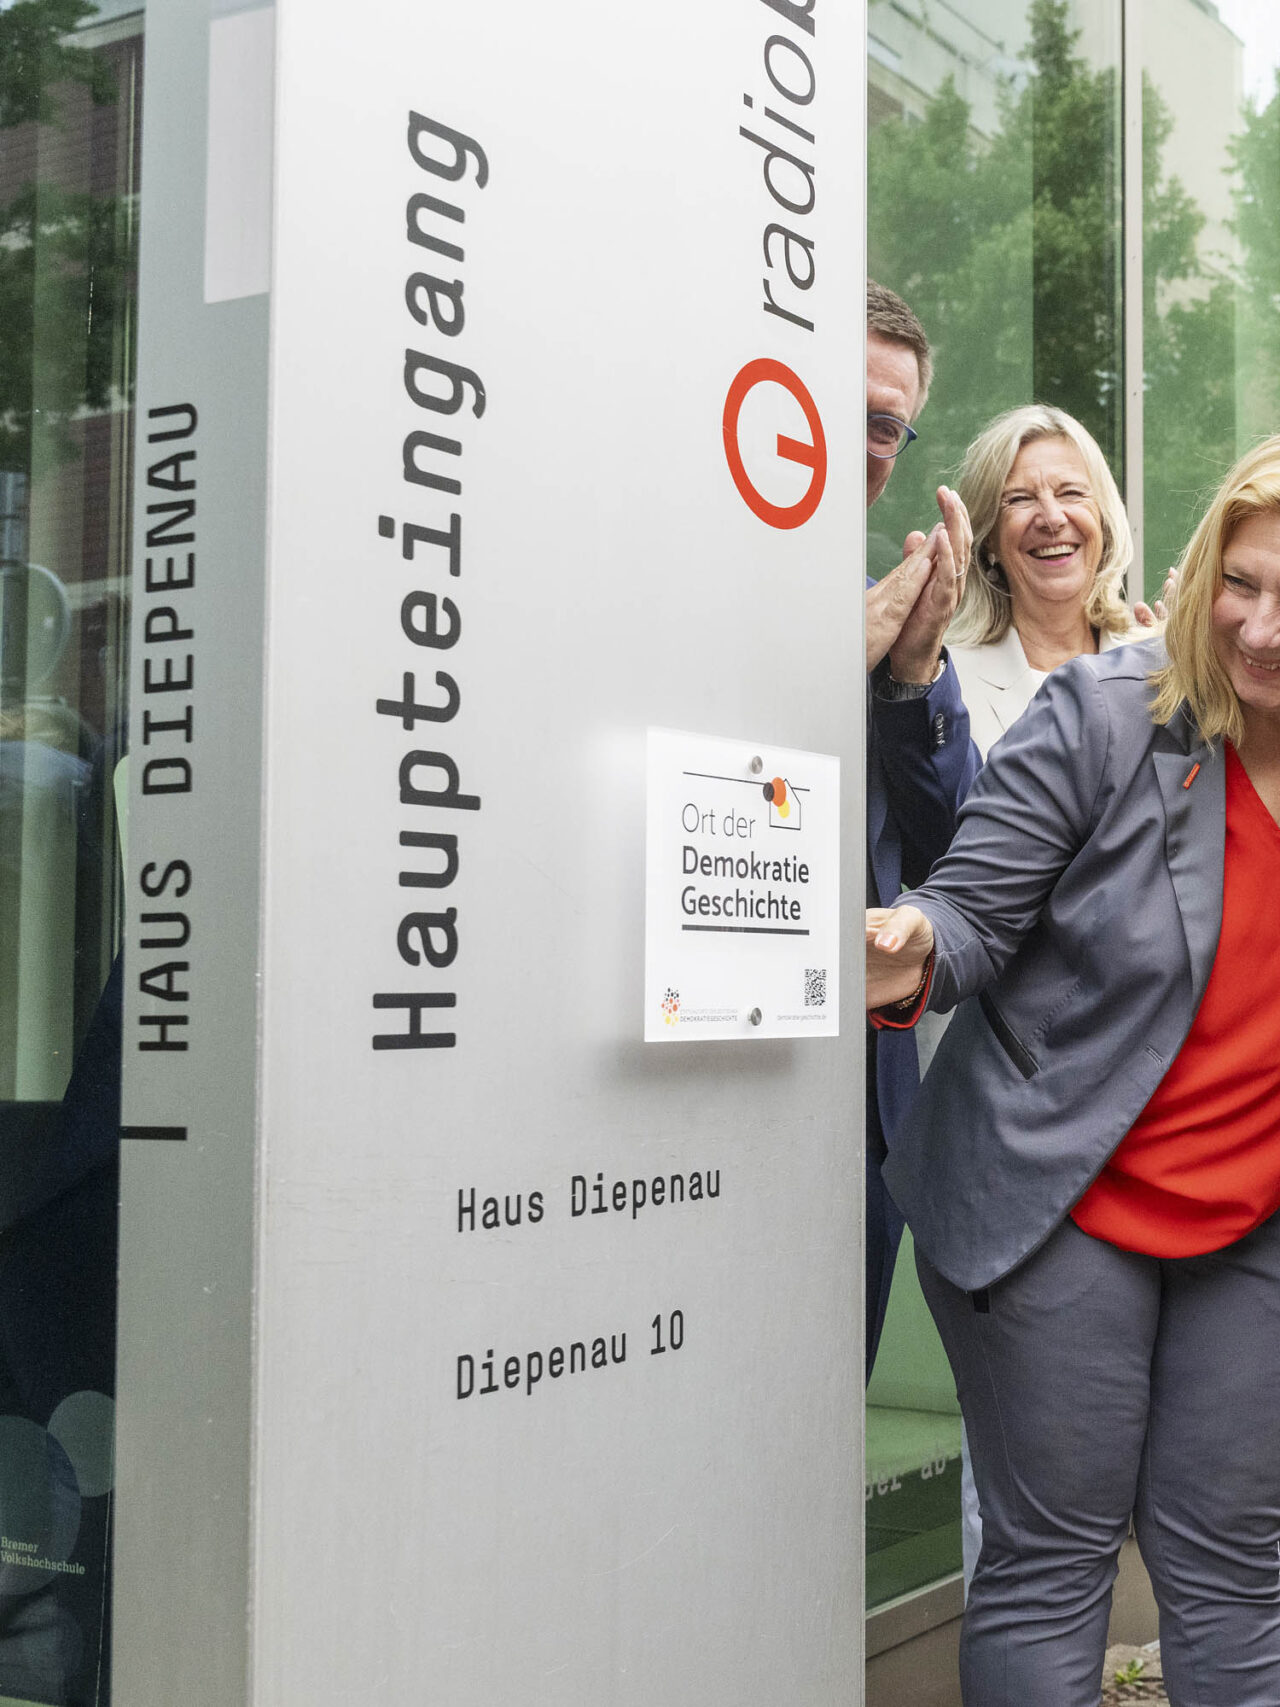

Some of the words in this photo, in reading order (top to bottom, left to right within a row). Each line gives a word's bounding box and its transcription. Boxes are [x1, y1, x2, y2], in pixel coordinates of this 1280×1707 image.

[143, 402, 198, 795] DIEPENAU
[371, 110, 489, 1051] Haupteingang
[681, 802, 717, 836] Ort
[722, 808, 756, 839] der
[682, 845, 810, 884] Demokratie
[681, 885, 801, 921] Geschichte
[138, 859, 192, 1052] HAUS
[458, 1187, 545, 1233] Haus
[571, 1168, 722, 1220] Diepenau
[457, 1331, 627, 1400] Diepenau
[650, 1309, 685, 1355] 10
[0, 1536, 39, 1553] Bremer
[0, 1550, 86, 1575] Volkshochschule
